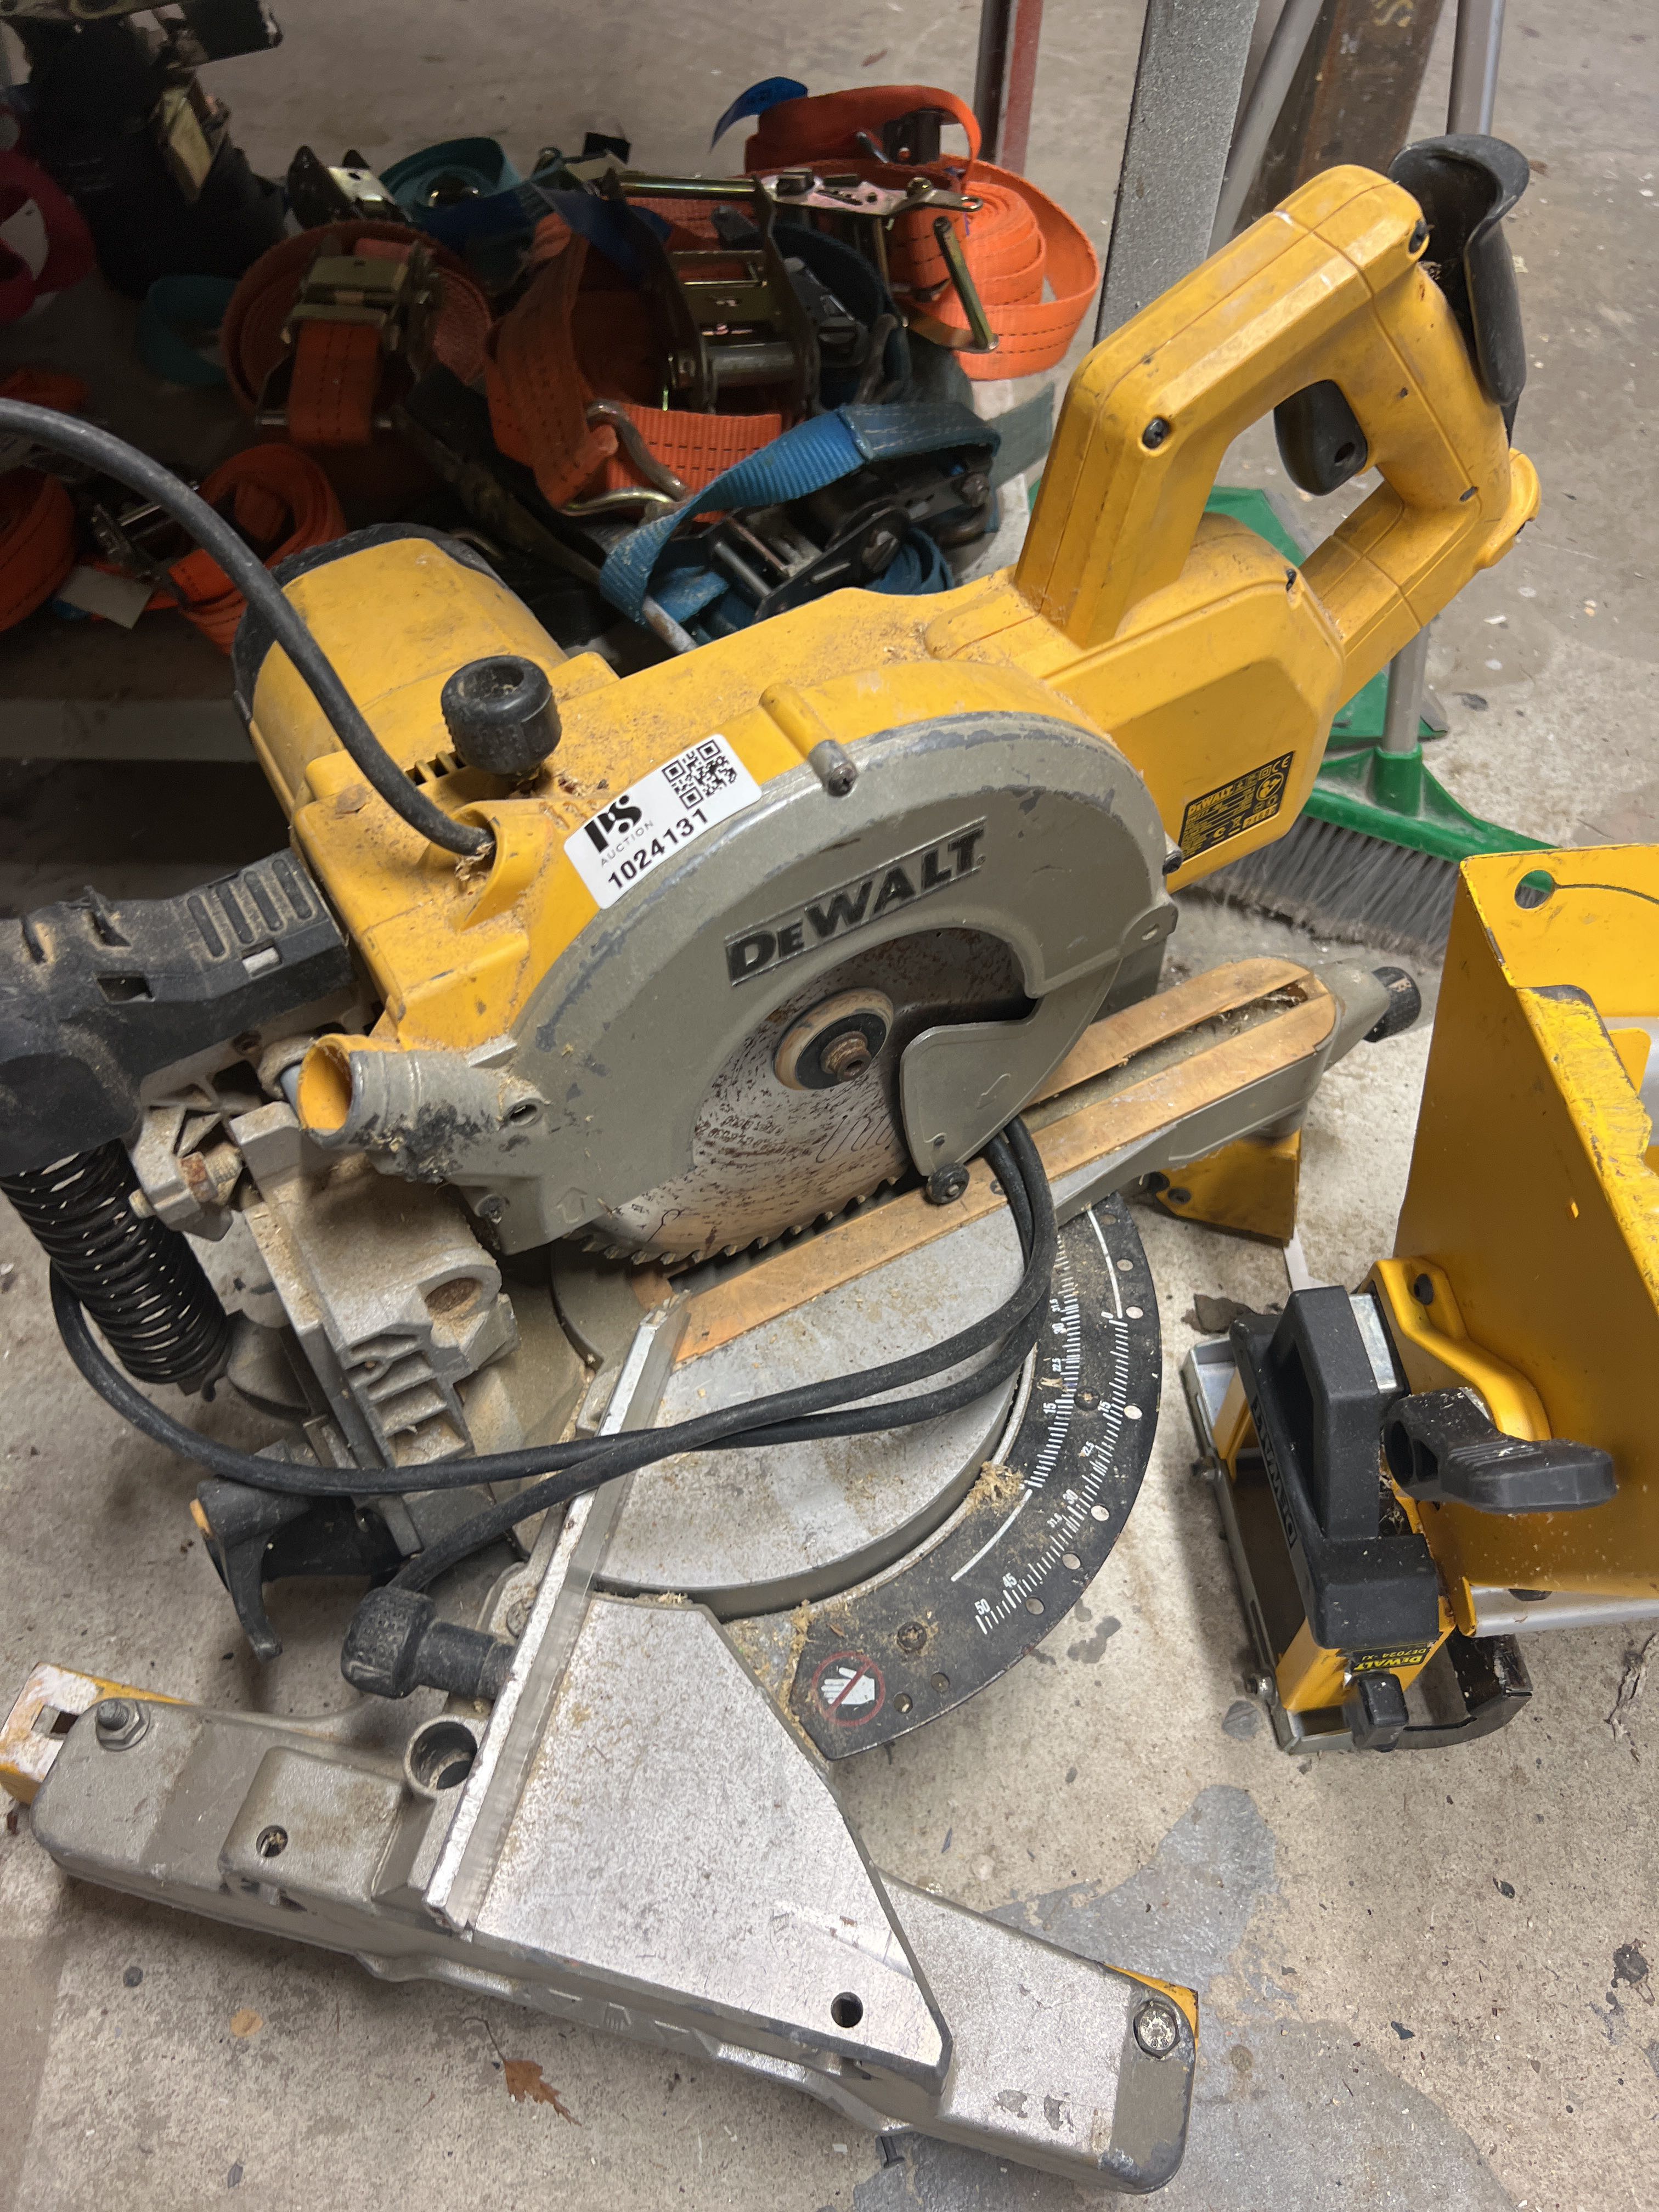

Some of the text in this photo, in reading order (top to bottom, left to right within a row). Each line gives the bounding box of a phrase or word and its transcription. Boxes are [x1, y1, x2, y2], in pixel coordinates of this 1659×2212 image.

[601, 820, 654, 867] AUCTION
[608, 809, 709, 890] 1024131
[727, 827, 985, 984] DEWALT
[1101, 1311, 1113, 1319] 0
[1043, 1402, 1057, 1414] 15
[1098, 1400, 1111, 1413] 15
[1063, 1489, 1078, 1504] 30
[1002, 1572, 1017, 1588] 45
[974, 1598, 990, 1615] 50
[1382, 1648, 1426, 1658] DE7024
[1353, 1655, 1423, 1671] DEWALT
